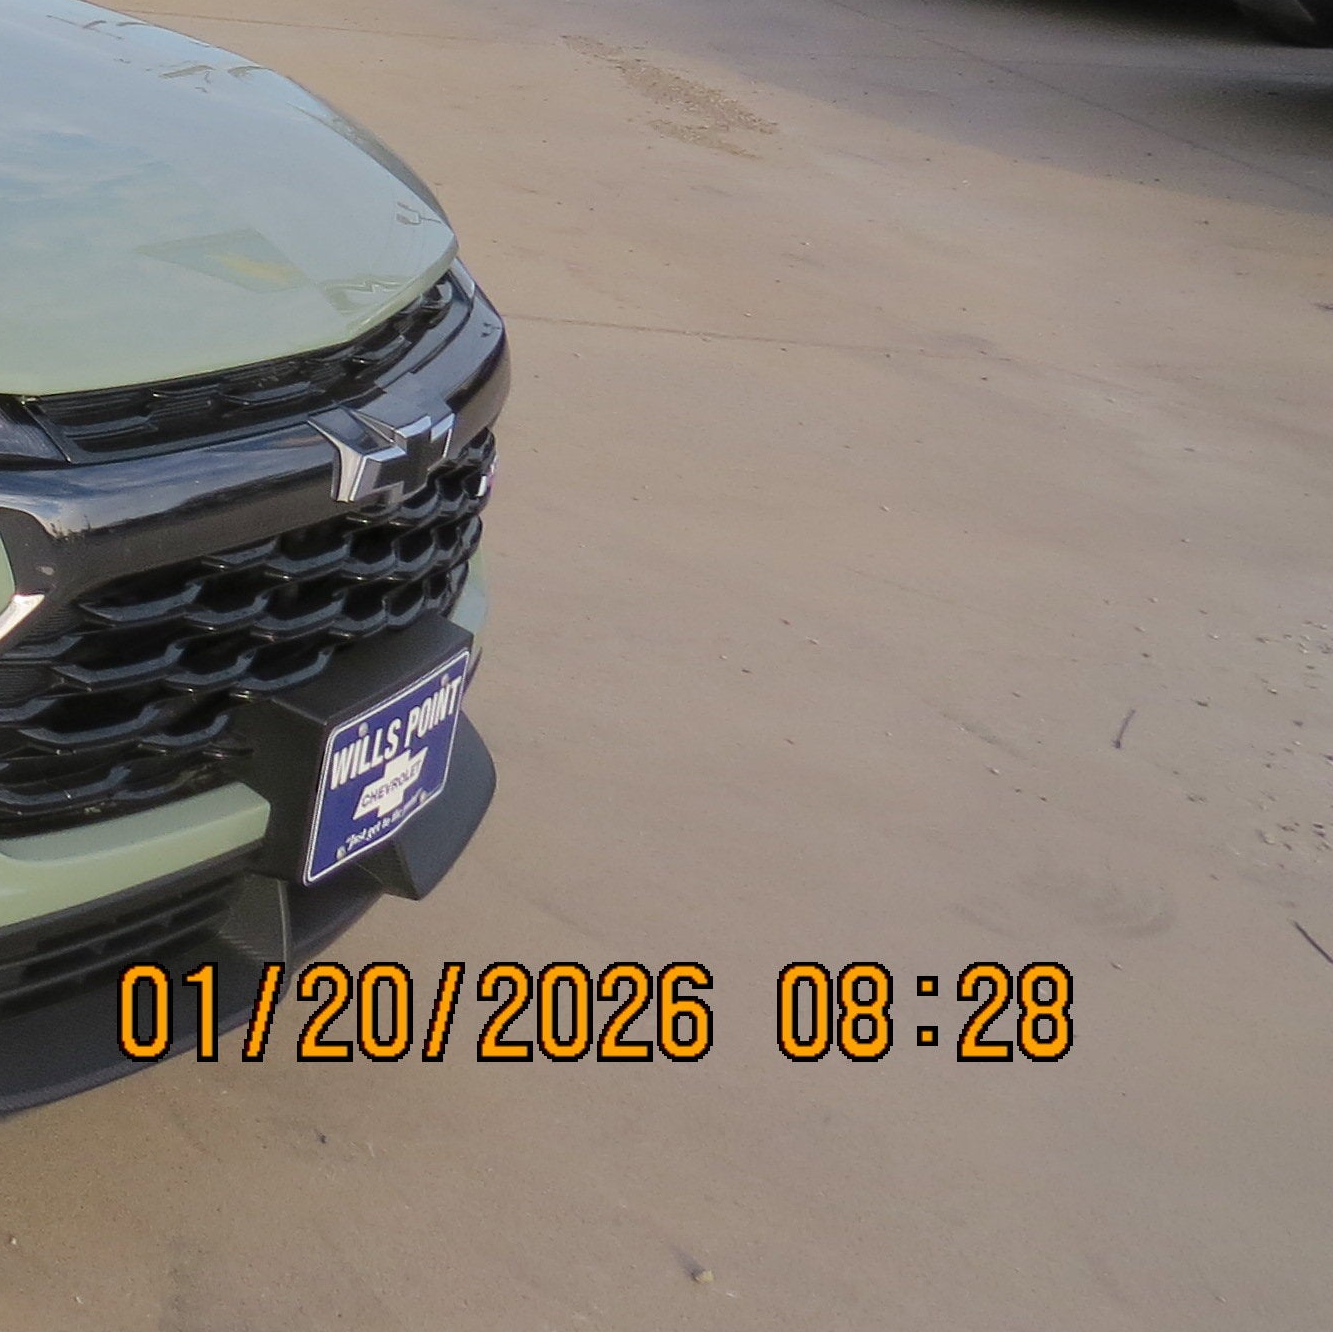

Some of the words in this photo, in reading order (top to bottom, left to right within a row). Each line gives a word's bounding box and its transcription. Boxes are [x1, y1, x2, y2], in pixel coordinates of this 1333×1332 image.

[330, 718, 402, 790] WILLS
[404, 675, 462, 748] POINT
[361, 759, 423, 808] CHEVROLET
